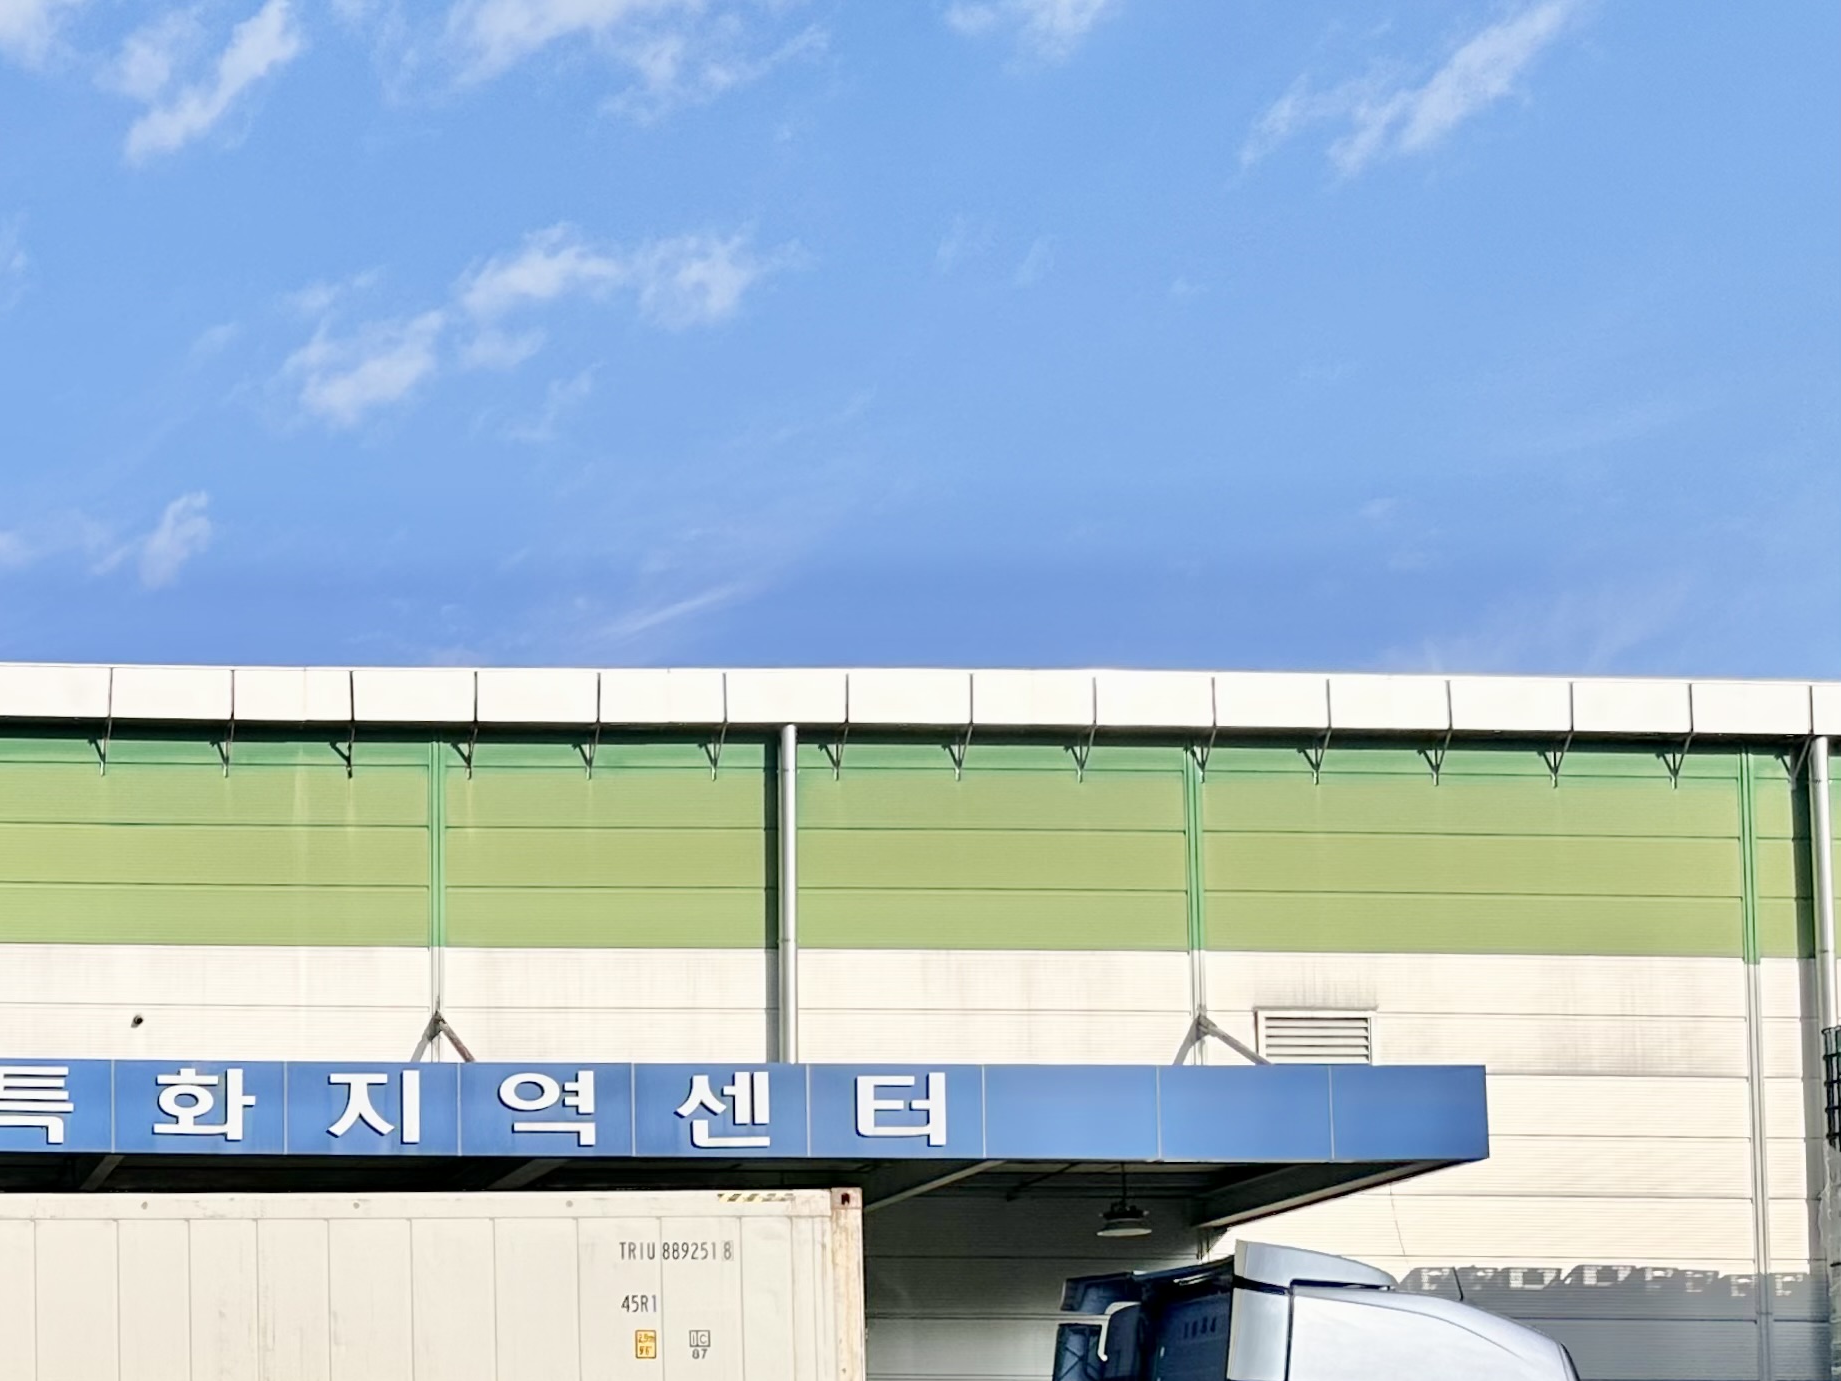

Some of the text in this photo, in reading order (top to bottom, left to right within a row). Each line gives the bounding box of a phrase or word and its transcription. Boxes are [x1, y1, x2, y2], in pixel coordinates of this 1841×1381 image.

[619, 1241, 655, 1260] TRIU
[662, 1241, 716, 1260] 889251
[620, 1294, 657, 1313] 45R1
